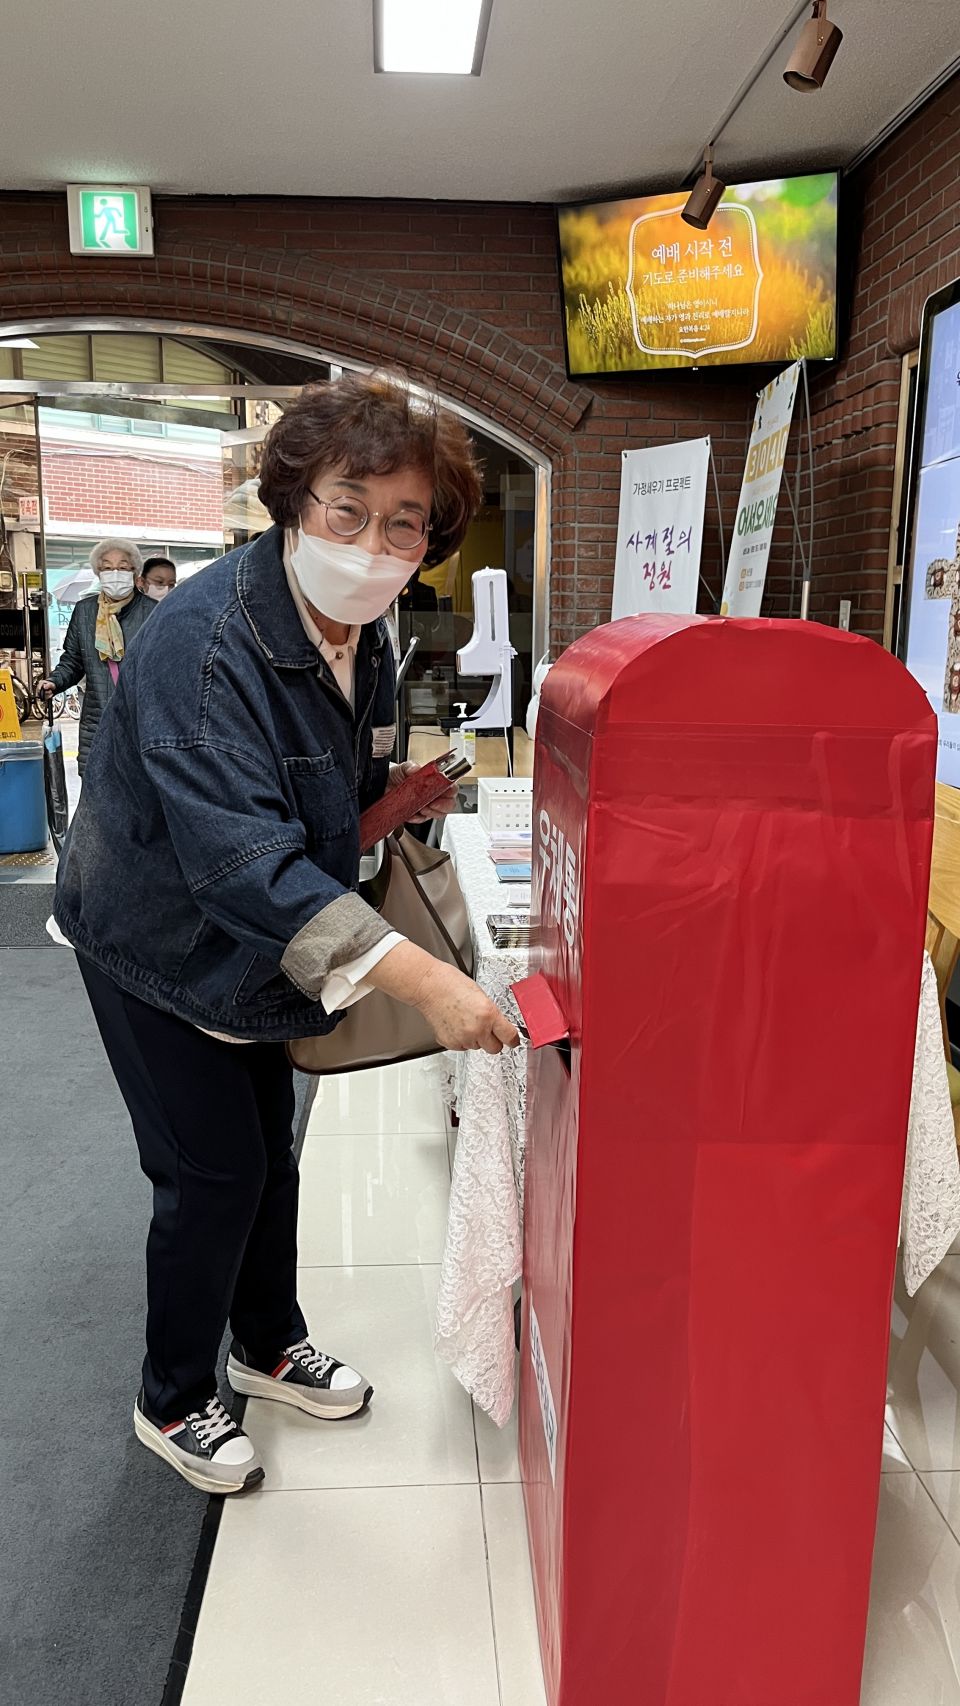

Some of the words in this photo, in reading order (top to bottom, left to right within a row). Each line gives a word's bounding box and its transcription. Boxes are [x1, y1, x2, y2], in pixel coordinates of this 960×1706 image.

[652, 242, 680, 264] 예배
[684, 238, 714, 261] 시작
[718, 236, 732, 257] 전
[643, 271, 675, 286] 기도로
[677, 263, 744, 283] 준비해주세요
[633, 480, 665, 496] 가정세우기
[665, 476, 691, 492] 프로젝트
[626, 525, 692, 555] 사계절의
[643, 560, 672, 591] 정원
[539, 809, 576, 947] 우체통
